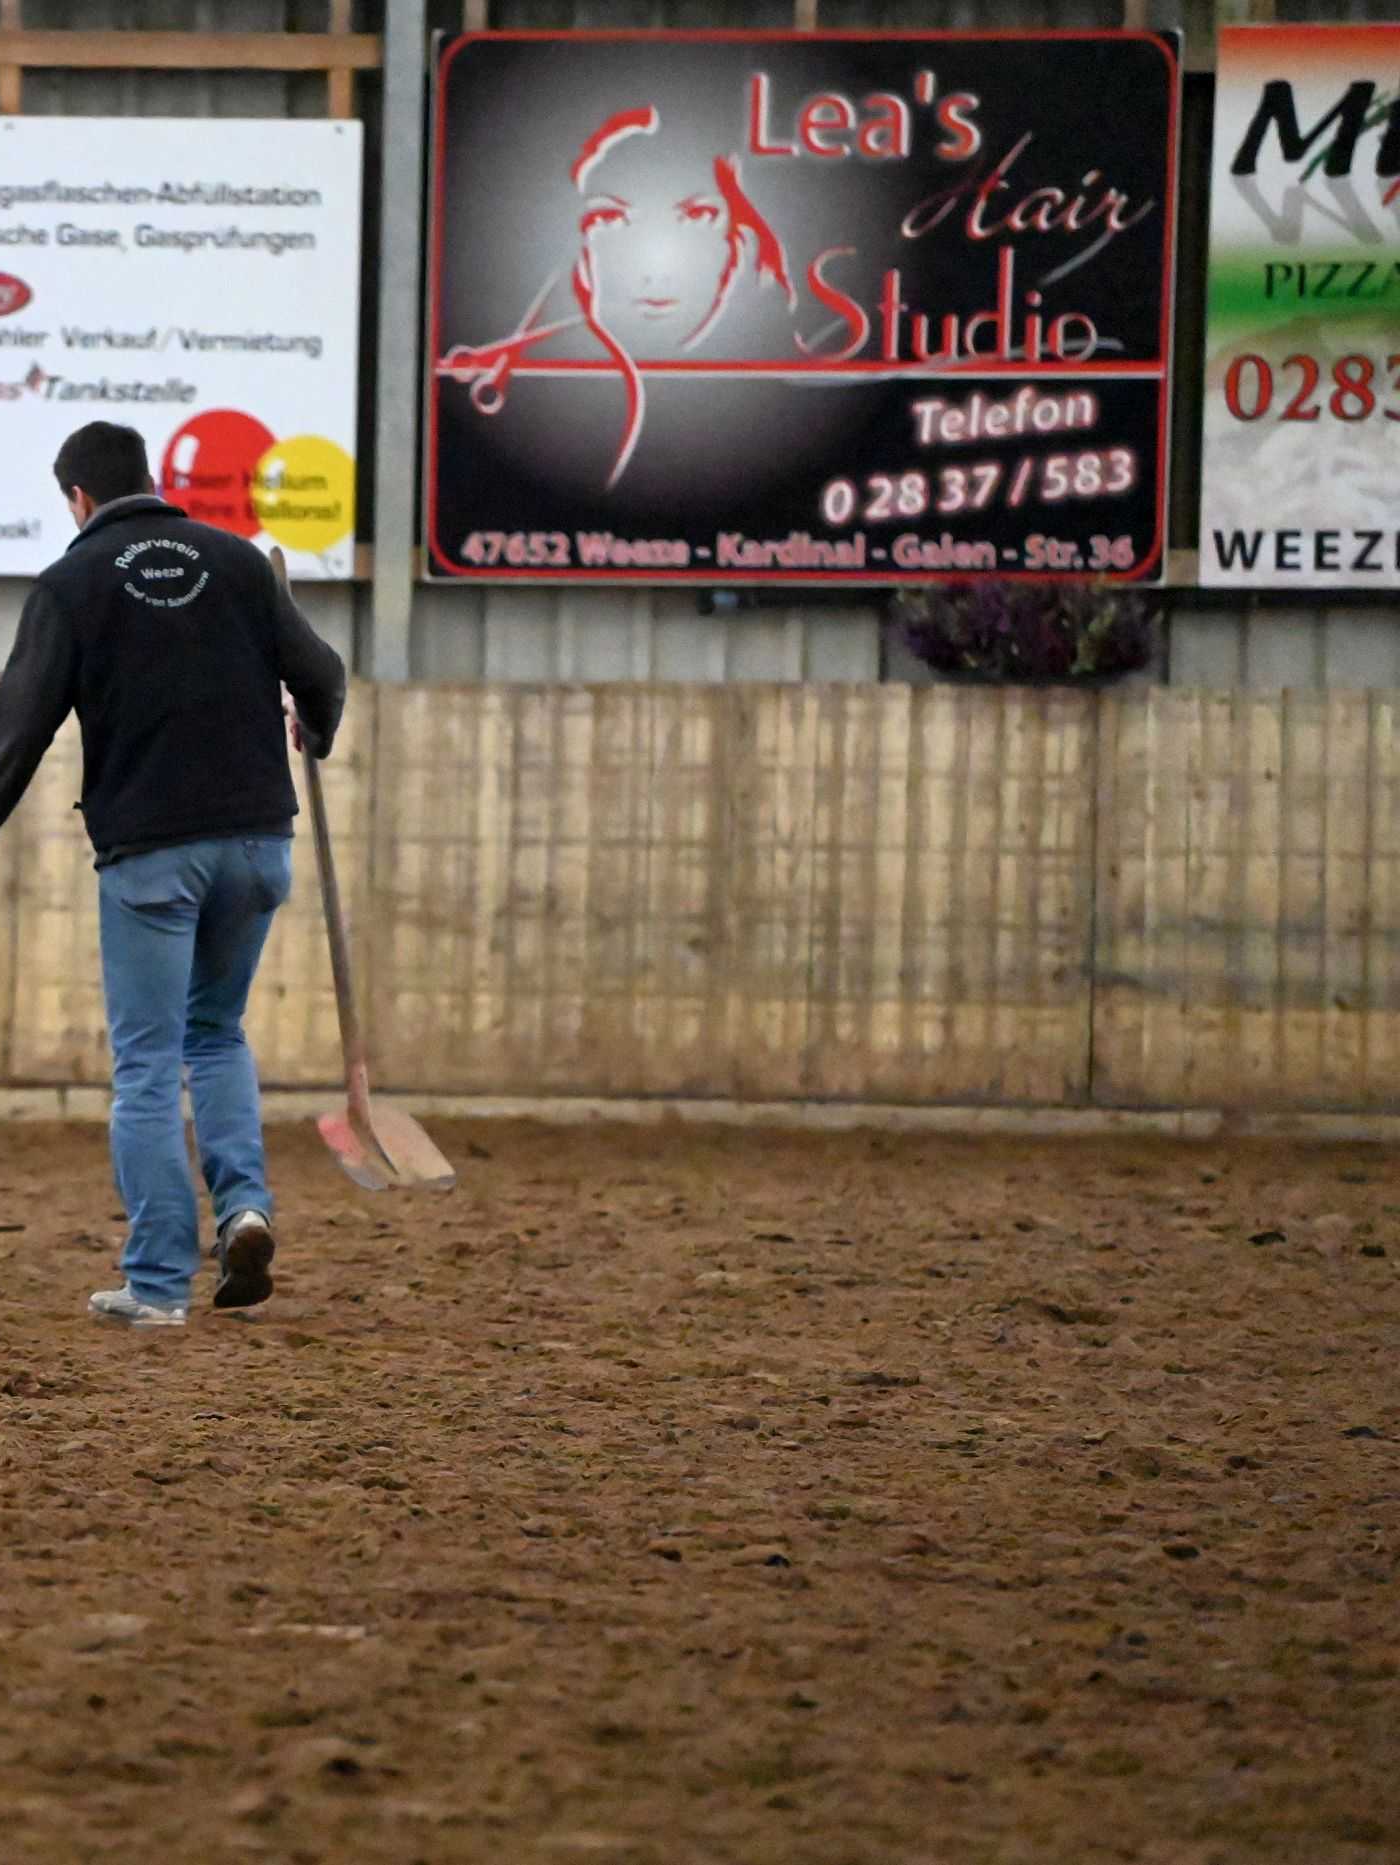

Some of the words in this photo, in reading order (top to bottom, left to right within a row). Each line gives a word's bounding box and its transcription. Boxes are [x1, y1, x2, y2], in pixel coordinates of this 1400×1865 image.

[748, 70, 981, 160] Lea's
[135, 223, 315, 255] Gasprüfungen
[795, 246, 1100, 362] Studio
[913, 386, 1096, 444] Telefon
[823, 479, 855, 525] 0
[864, 471, 928, 521] 28
[938, 463, 1000, 512] 37
[1041, 449, 1133, 500] 583
[115, 539, 200, 569] Reiterverein
[461, 531, 571, 566] 47652
[717, 531, 866, 569] Kardinal
[892, 532, 997, 570] Galen
[1213, 529, 1400, 571] WEEZ
[140, 567, 184, 580] Weeze
